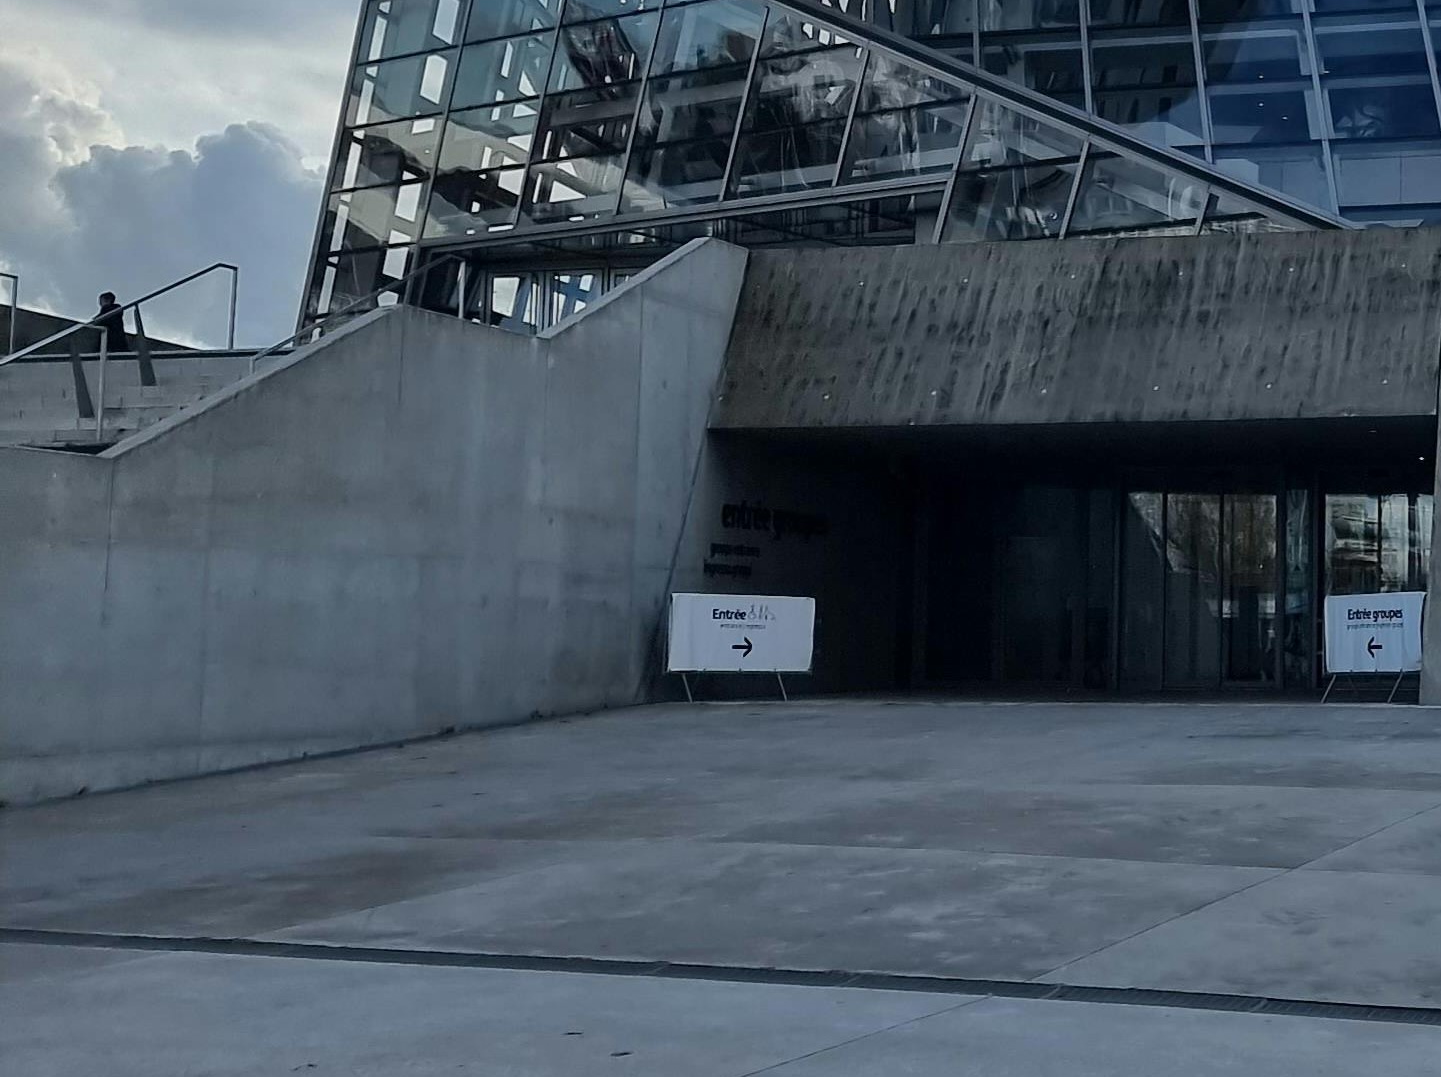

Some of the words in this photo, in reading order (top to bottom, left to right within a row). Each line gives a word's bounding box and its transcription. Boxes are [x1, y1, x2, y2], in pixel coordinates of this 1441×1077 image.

[712, 608, 747, 620] Entrée
[1347, 608, 1371, 620] Entrée
[1372, 609, 1403, 622] groupes
